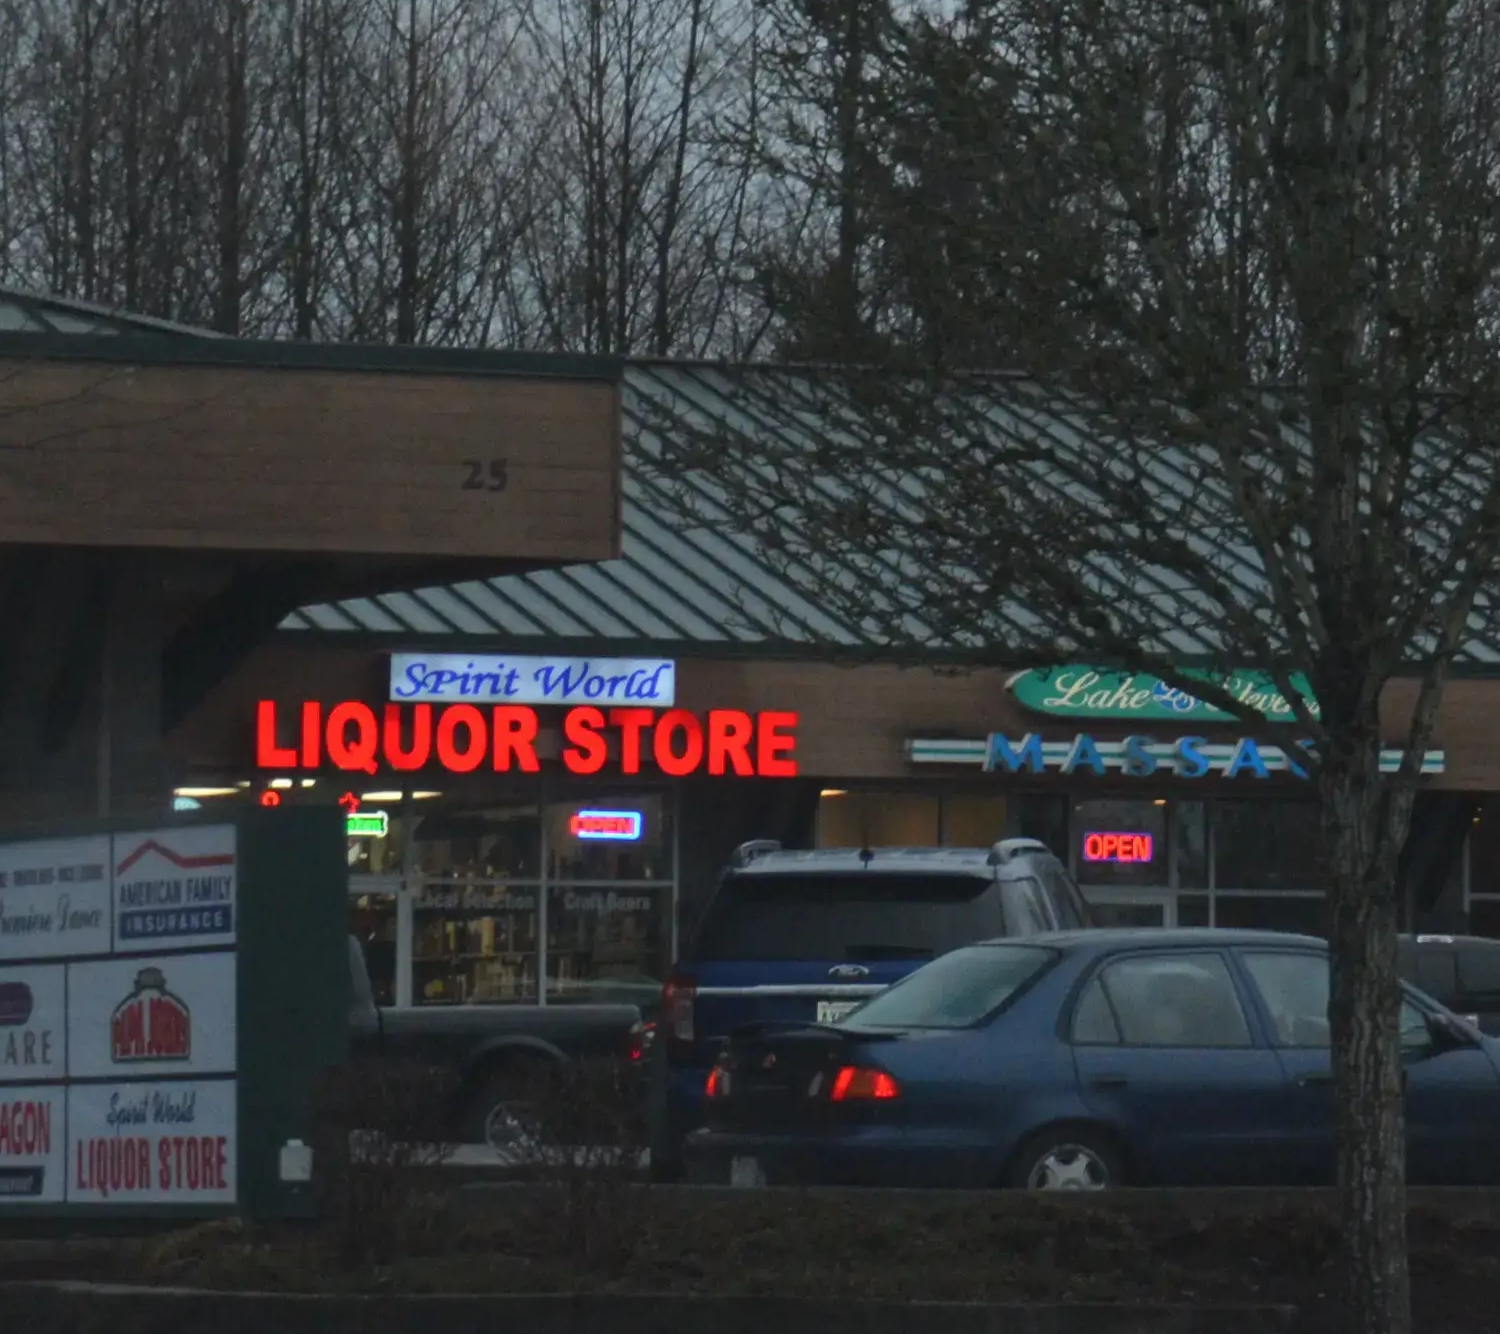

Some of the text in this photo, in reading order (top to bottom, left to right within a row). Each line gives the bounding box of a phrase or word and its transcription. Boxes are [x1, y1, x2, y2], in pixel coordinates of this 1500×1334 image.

[461, 457, 508, 492] 25
[533, 664, 671, 699] World
[1043, 670, 1150, 709] Lake
[256, 699, 798, 777] LIQUOR STORE
[982, 731, 1322, 779] MASSA
[1085, 833, 1153, 861] OPEN
[120, 875, 232, 906] AMERICAN FAMILY
[126, 911, 224, 933] INSURANCE
[152, 1091, 197, 1125] World
[77, 1135, 228, 1198] LIQUOR STORE
